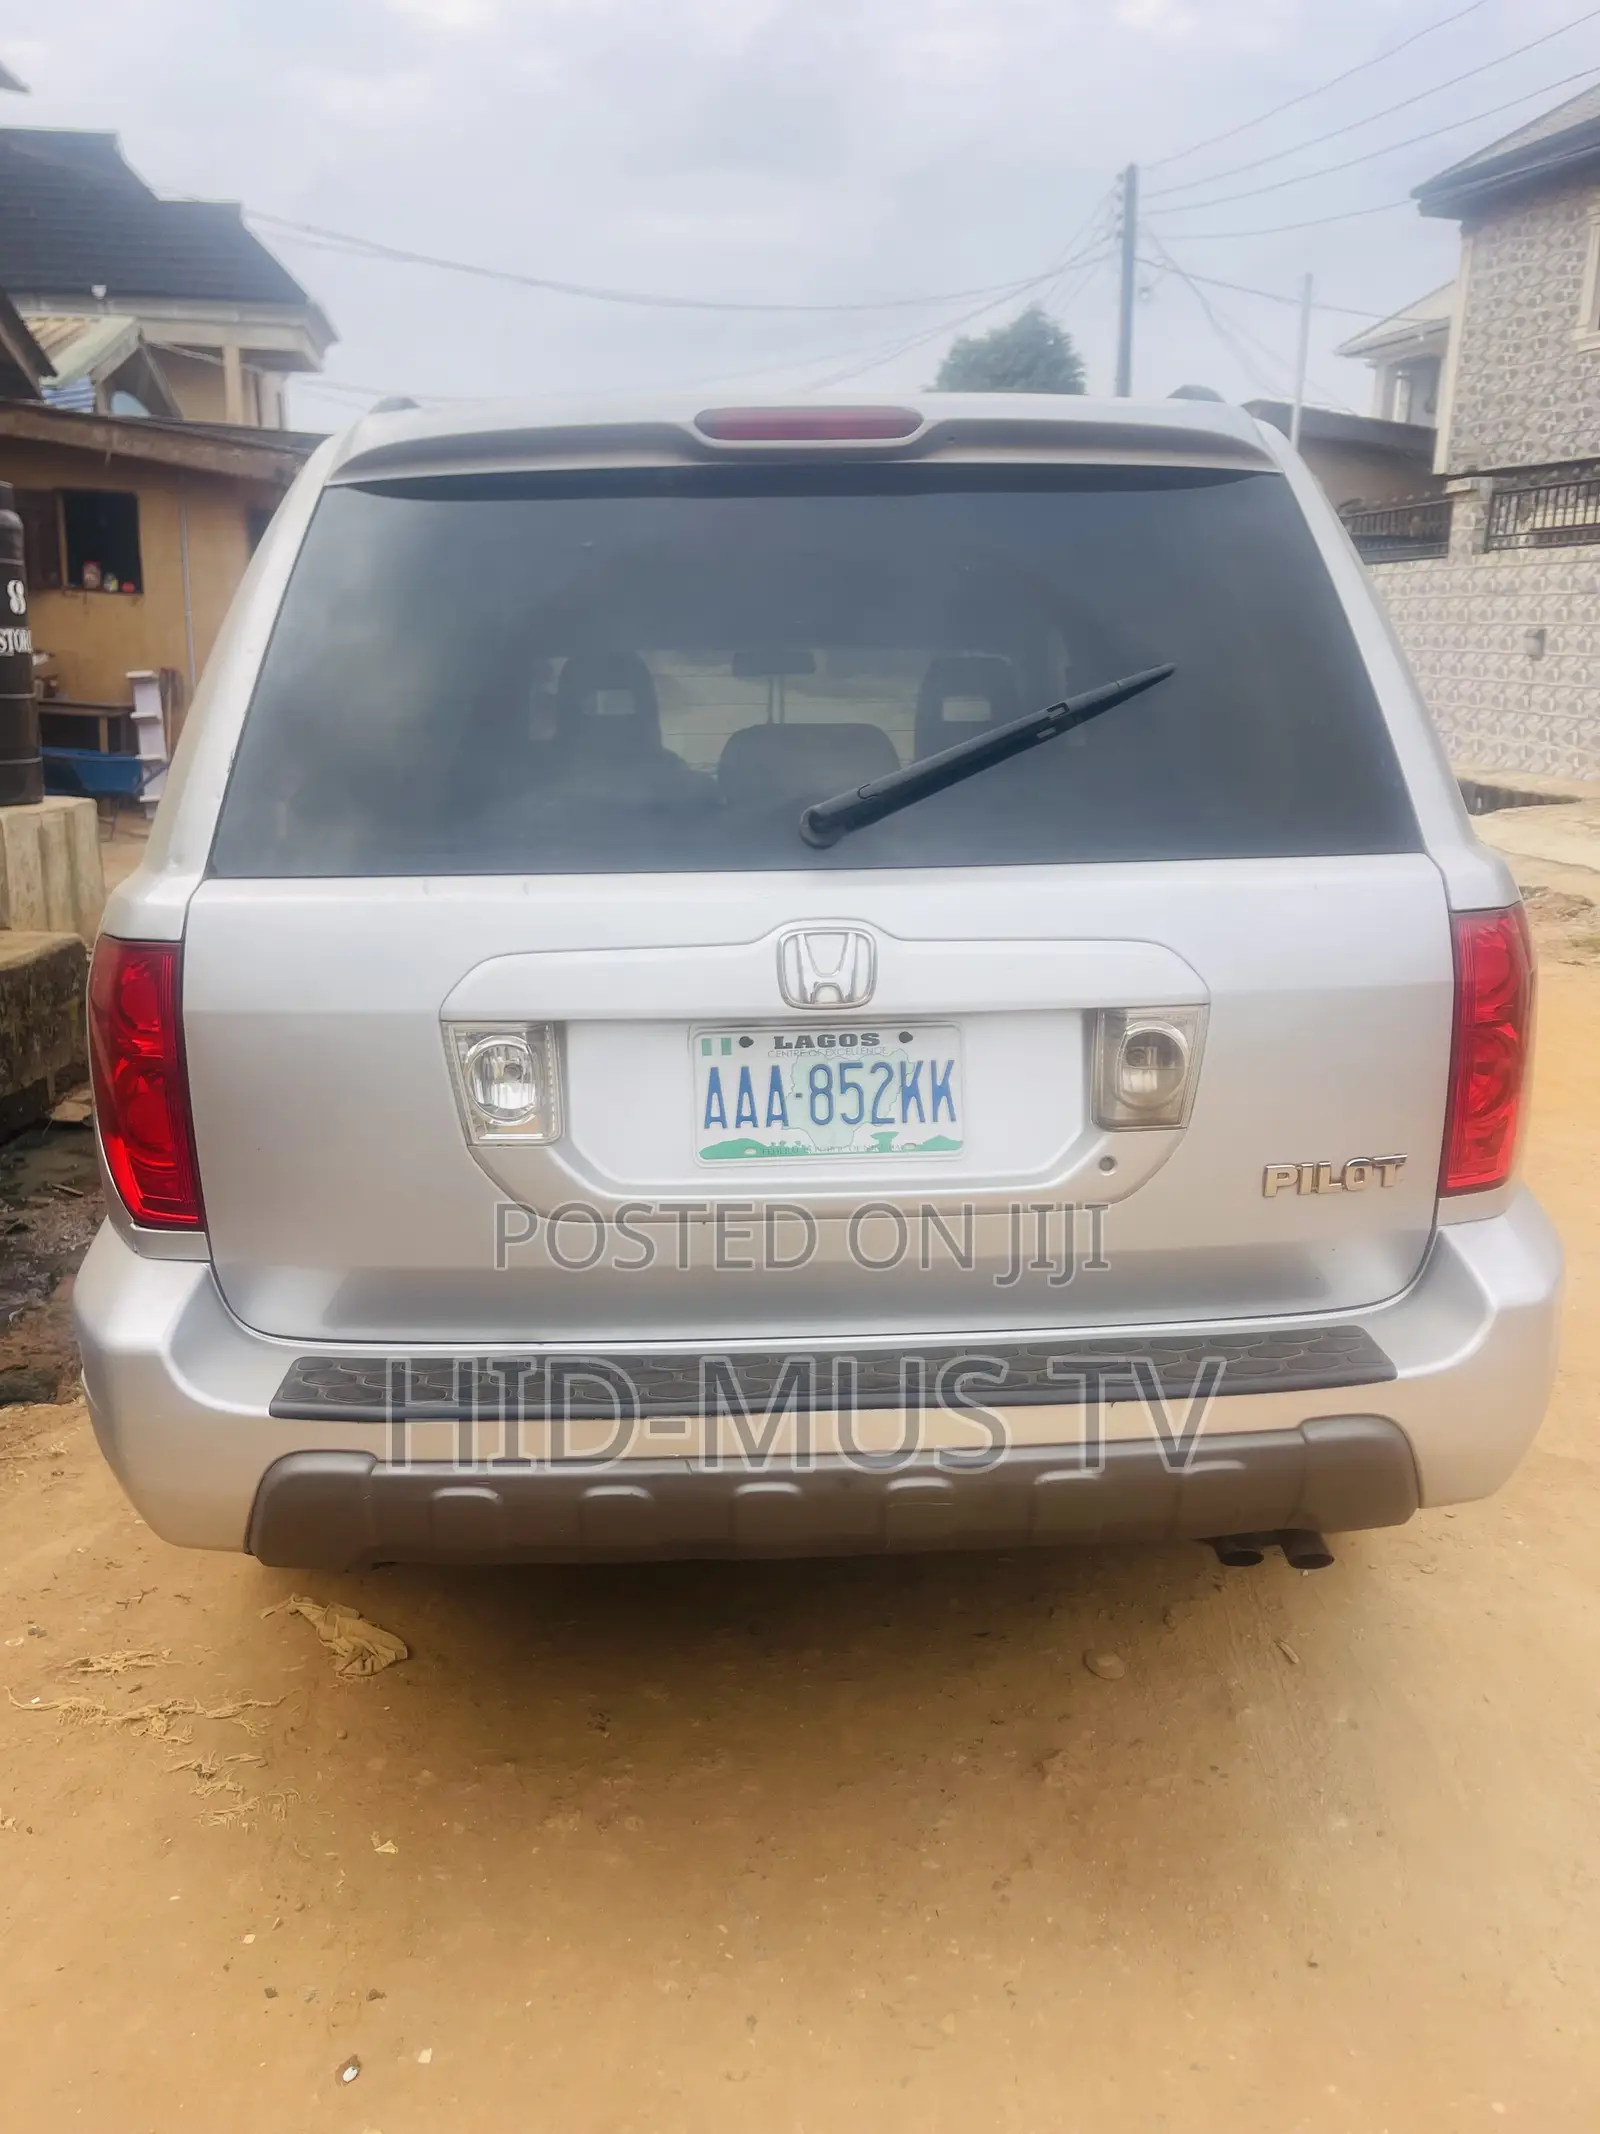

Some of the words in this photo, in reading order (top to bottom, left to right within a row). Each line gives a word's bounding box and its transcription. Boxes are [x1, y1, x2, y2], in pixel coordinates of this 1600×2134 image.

[6, 579, 27, 615] 8
[767, 1049, 809, 1058] CENTRE
[809, 1048, 823, 1057] OF
[825, 1046, 888, 1056] EXCELLENCE
[773, 1033, 881, 1050] LAGOS
[1262, 1153, 1408, 1198] PILOT
